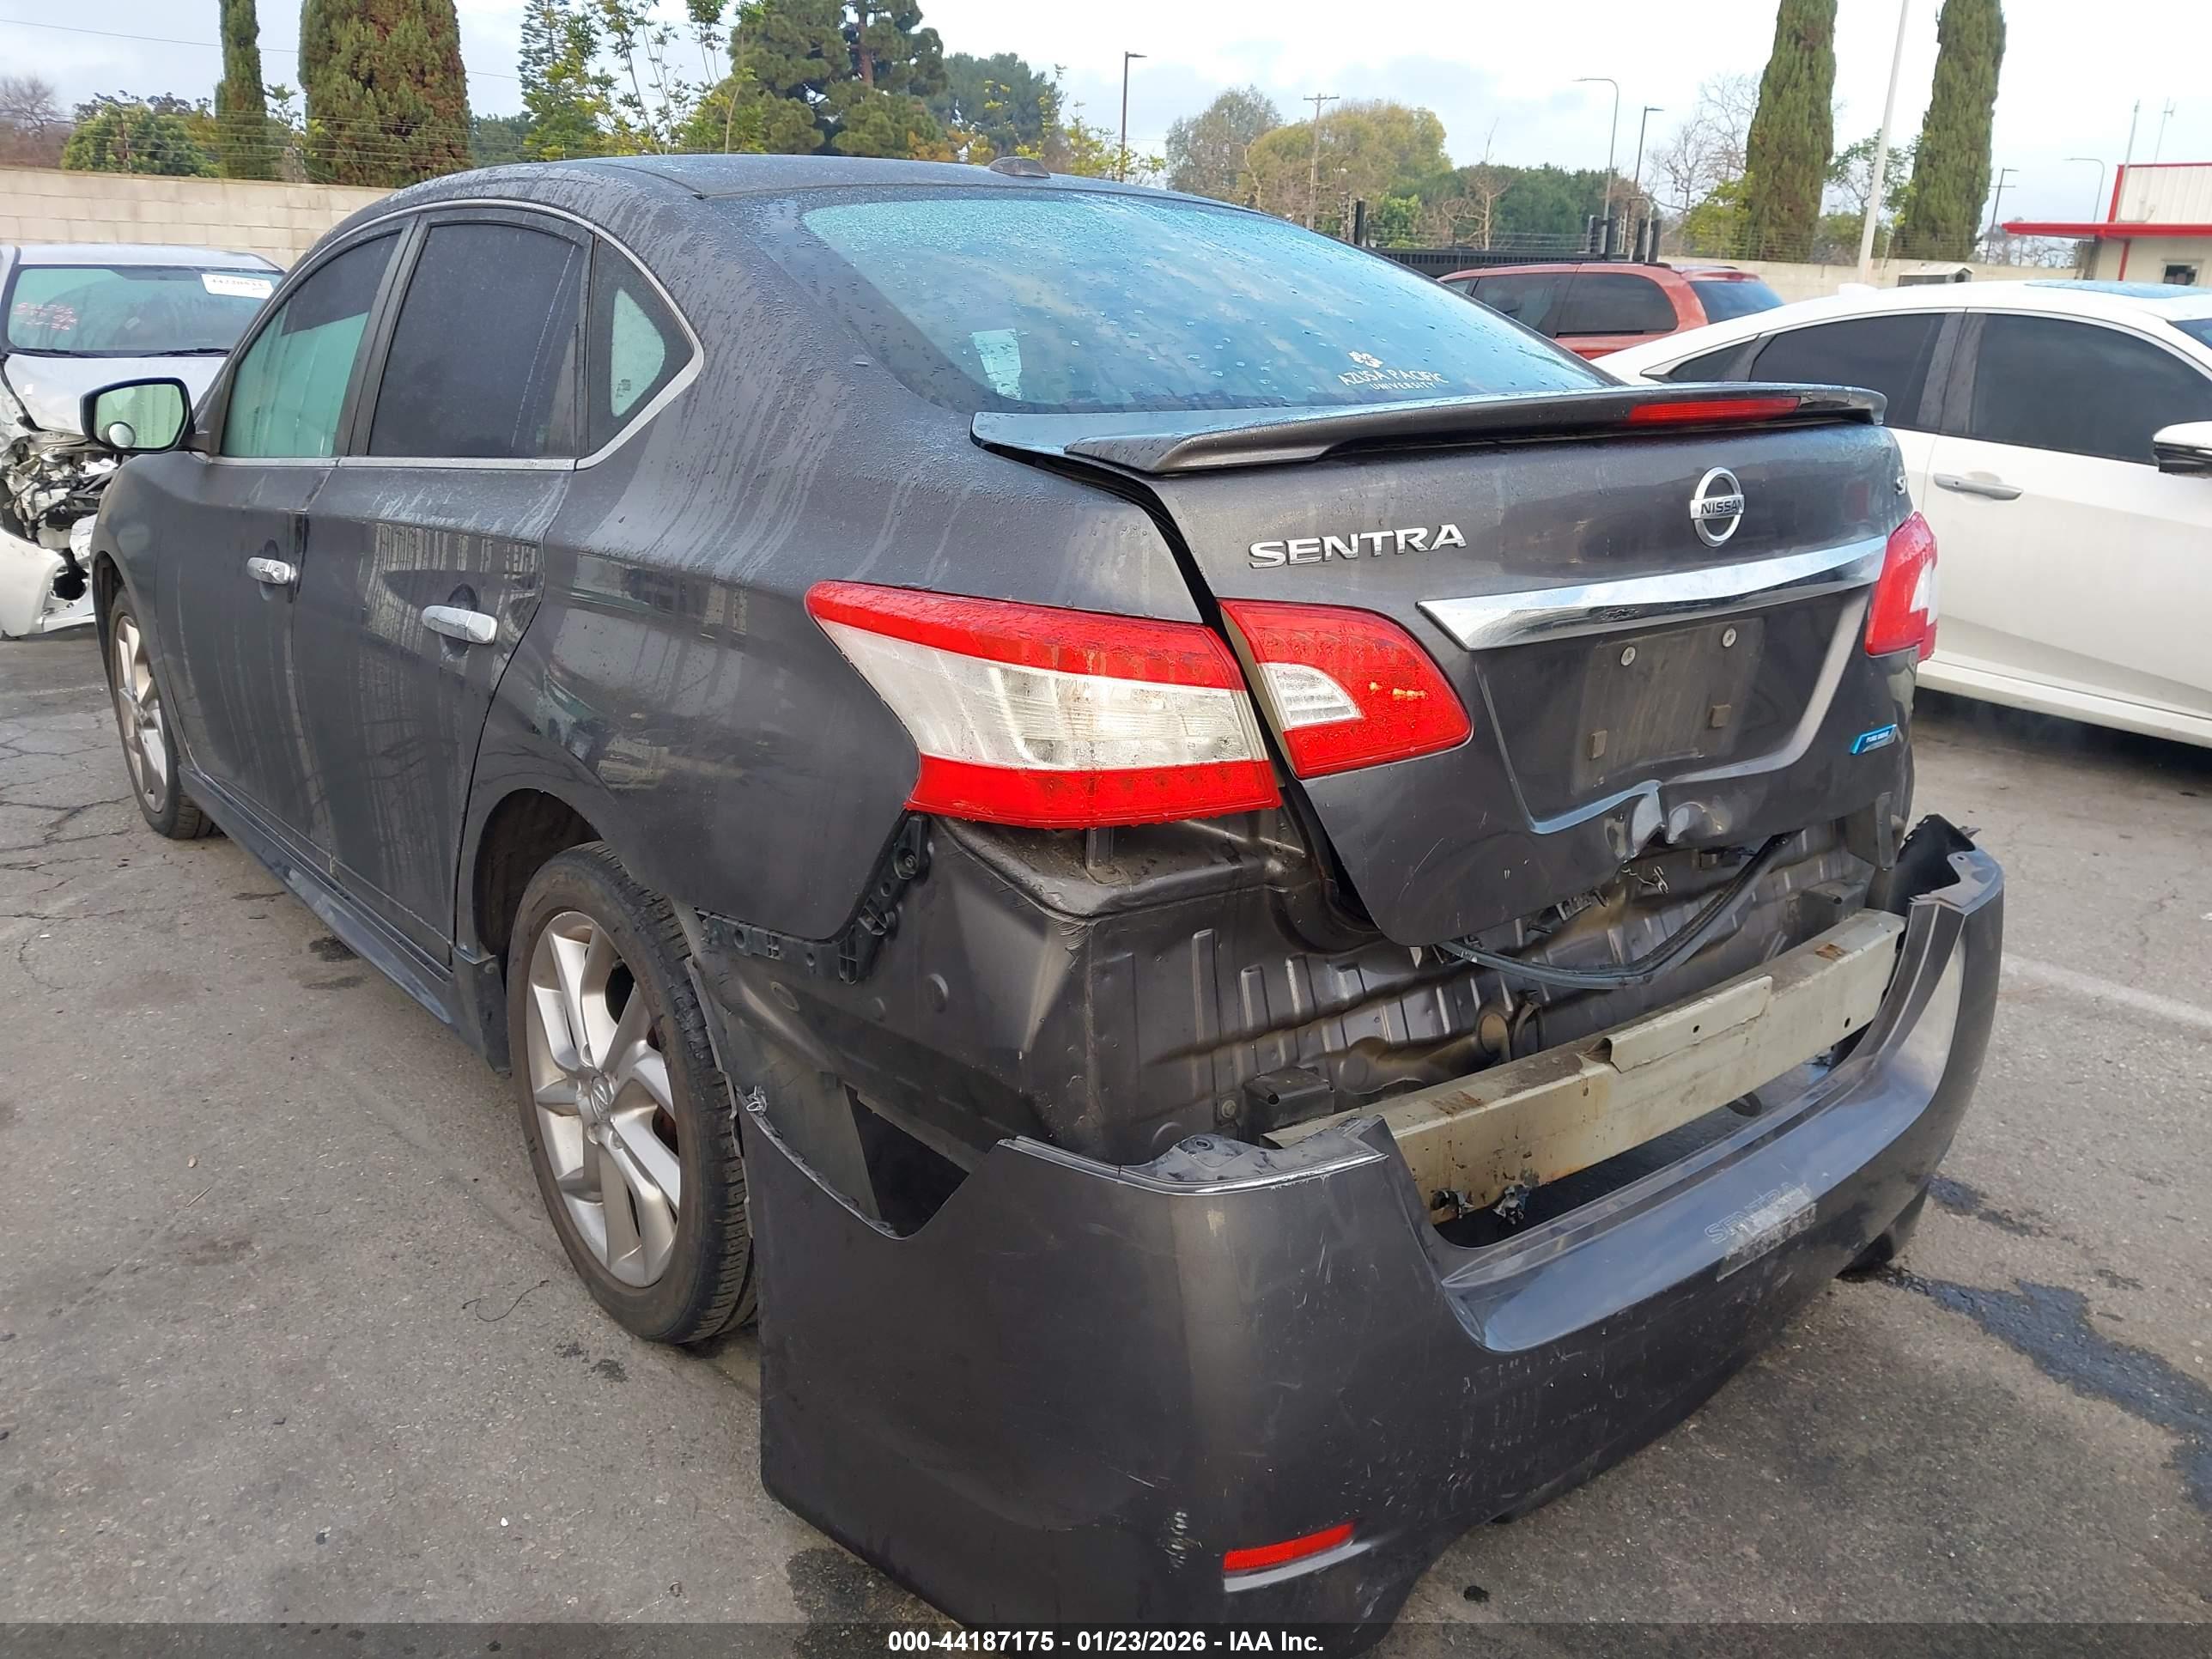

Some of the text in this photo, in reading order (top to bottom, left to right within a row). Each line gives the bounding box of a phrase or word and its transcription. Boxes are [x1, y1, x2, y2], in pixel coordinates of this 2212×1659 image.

[1337, 369, 1449, 386] AZUSA PACIFIC
[1369, 381, 1437, 391] UNIVERSITY
[1700, 499, 1743, 515] NISSAN
[1249, 523, 1468, 568] SENTRA
